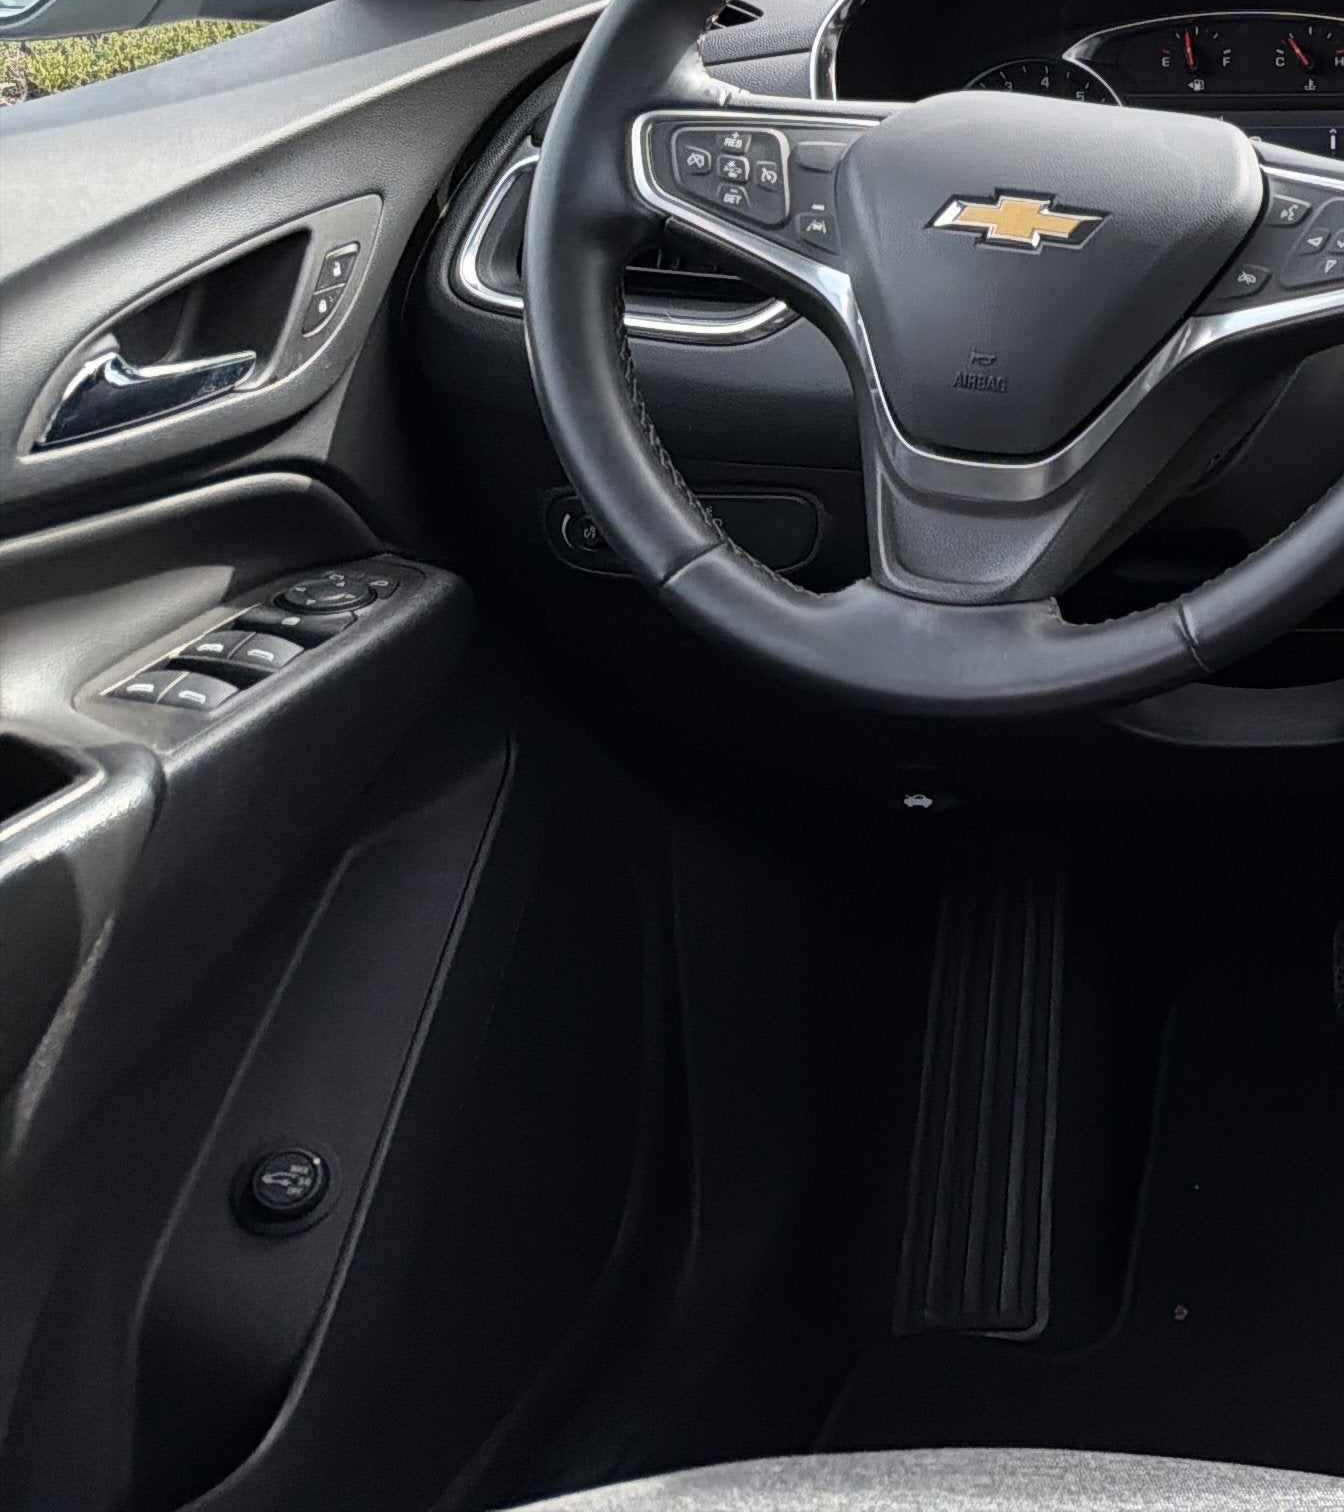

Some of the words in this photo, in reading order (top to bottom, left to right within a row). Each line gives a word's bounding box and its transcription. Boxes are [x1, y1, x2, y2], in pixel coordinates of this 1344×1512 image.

[1161, 57, 1171, 67] E
[1222, 57, 1231, 67] F
[1275, 57, 1285, 67] C
[1334, 57, 1344, 67] H
[1004, 81, 1013, 91] 3
[1040, 76, 1050, 89] 4
[1075, 91, 1085, 102] 5
[951, 370, 1010, 394] AIRBAG
